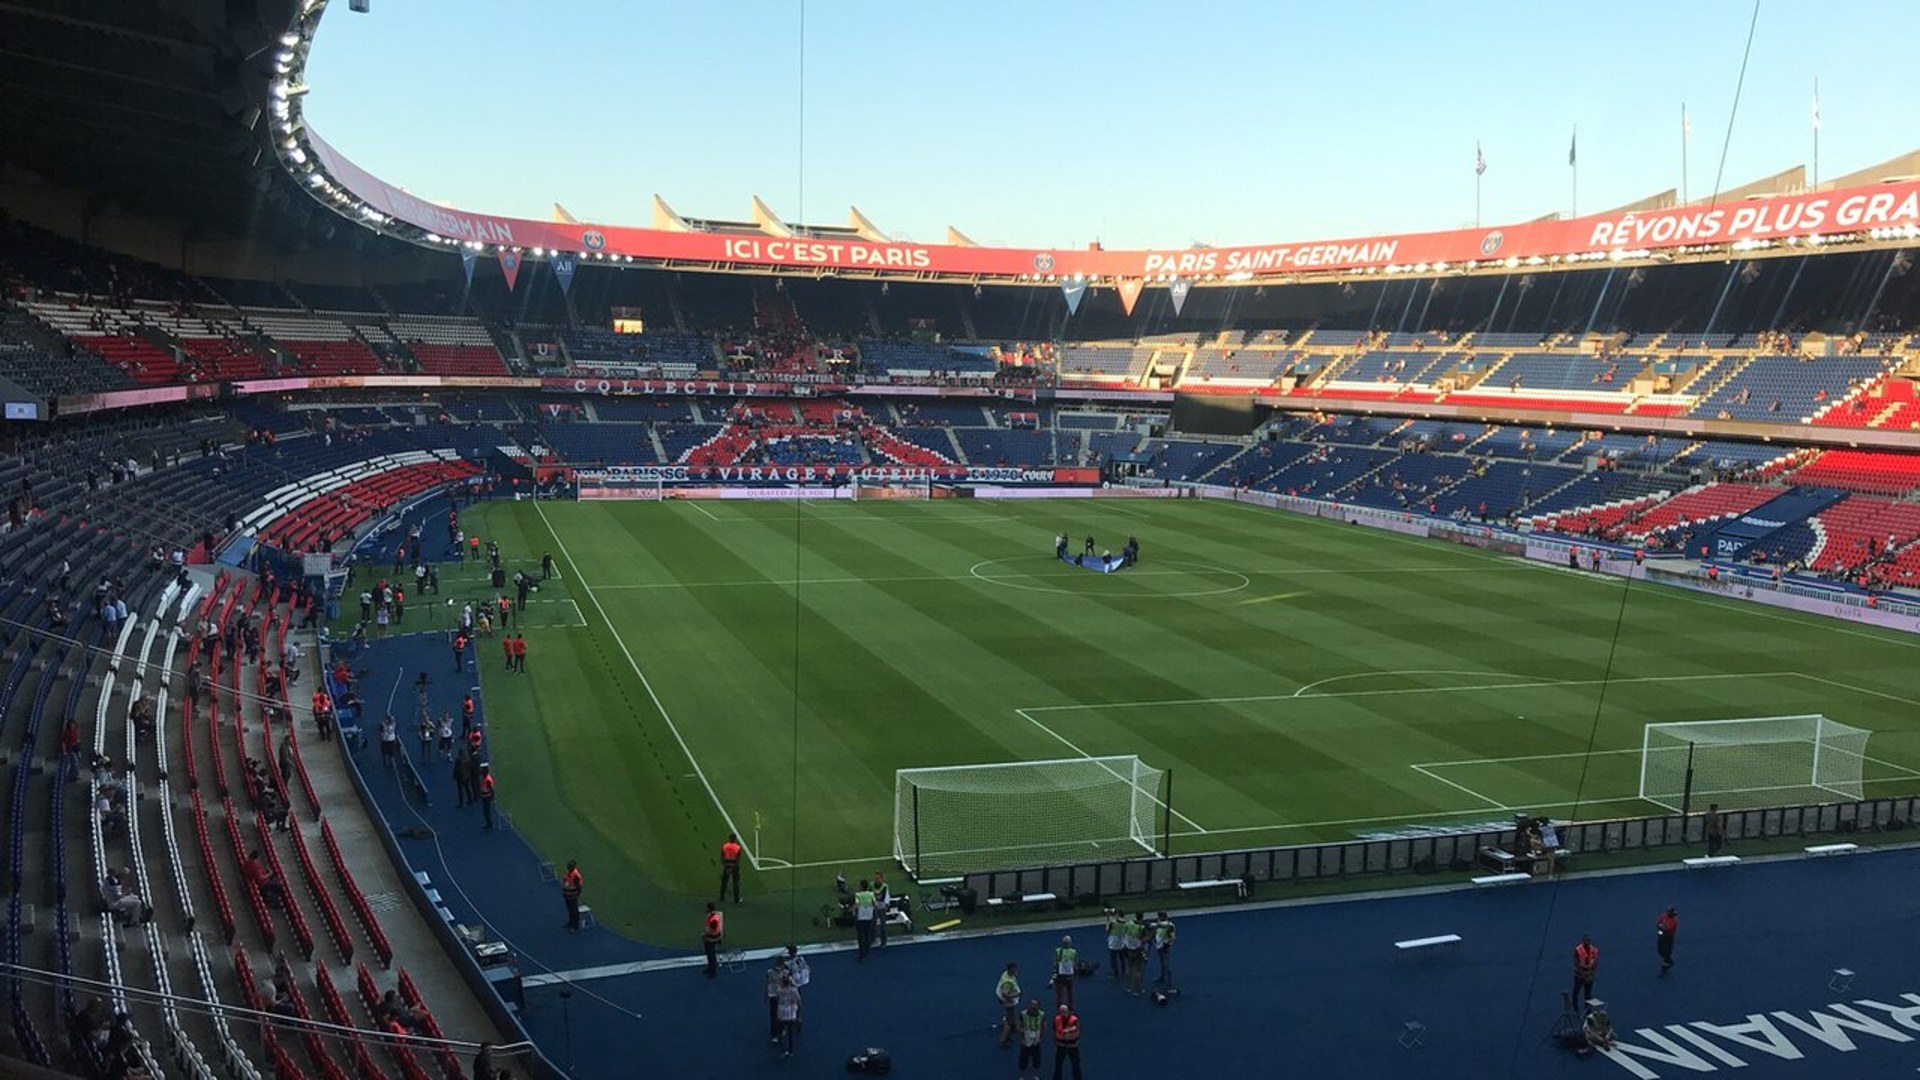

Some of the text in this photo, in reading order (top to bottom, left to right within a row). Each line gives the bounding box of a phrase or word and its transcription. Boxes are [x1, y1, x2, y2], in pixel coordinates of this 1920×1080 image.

[1589, 211, 1725, 247] RÊVONS
[1728, 199, 1829, 235] PLUS
[725, 239, 931, 267] ICI C'EST PARIS
[1144, 240, 1399, 272] PARIS SAINT-GERMAIN
[574, 379, 757, 396] COLLECTIF
[719, 467, 816, 481] VIRAGE
[849, 469, 940, 481] AUTEUIL
